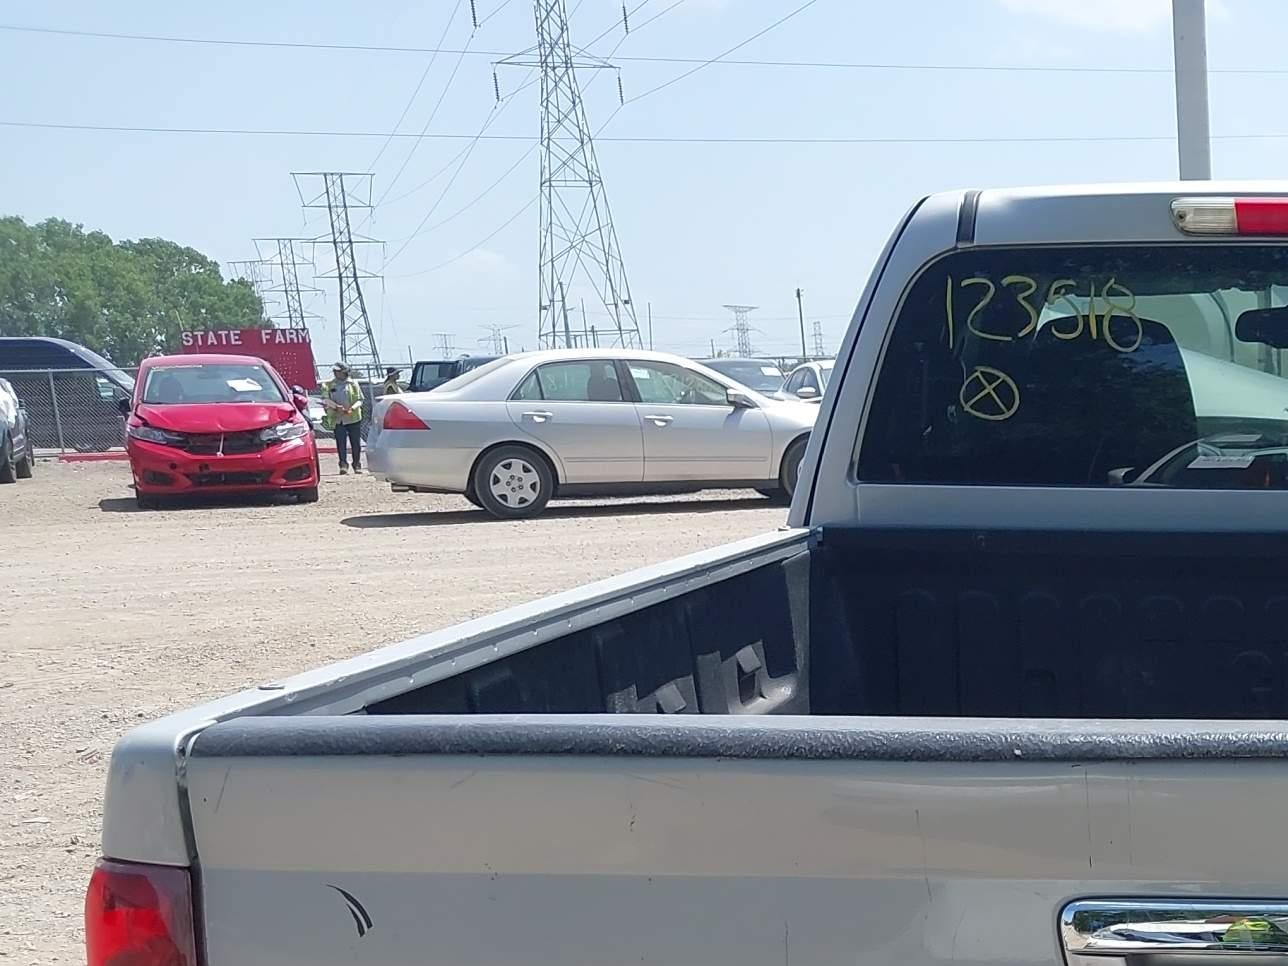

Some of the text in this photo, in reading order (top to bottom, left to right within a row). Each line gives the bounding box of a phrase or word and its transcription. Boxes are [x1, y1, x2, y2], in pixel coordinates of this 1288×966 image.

[945, 275, 1143, 352] 123518
[181, 329, 311, 346] STATE FARM
